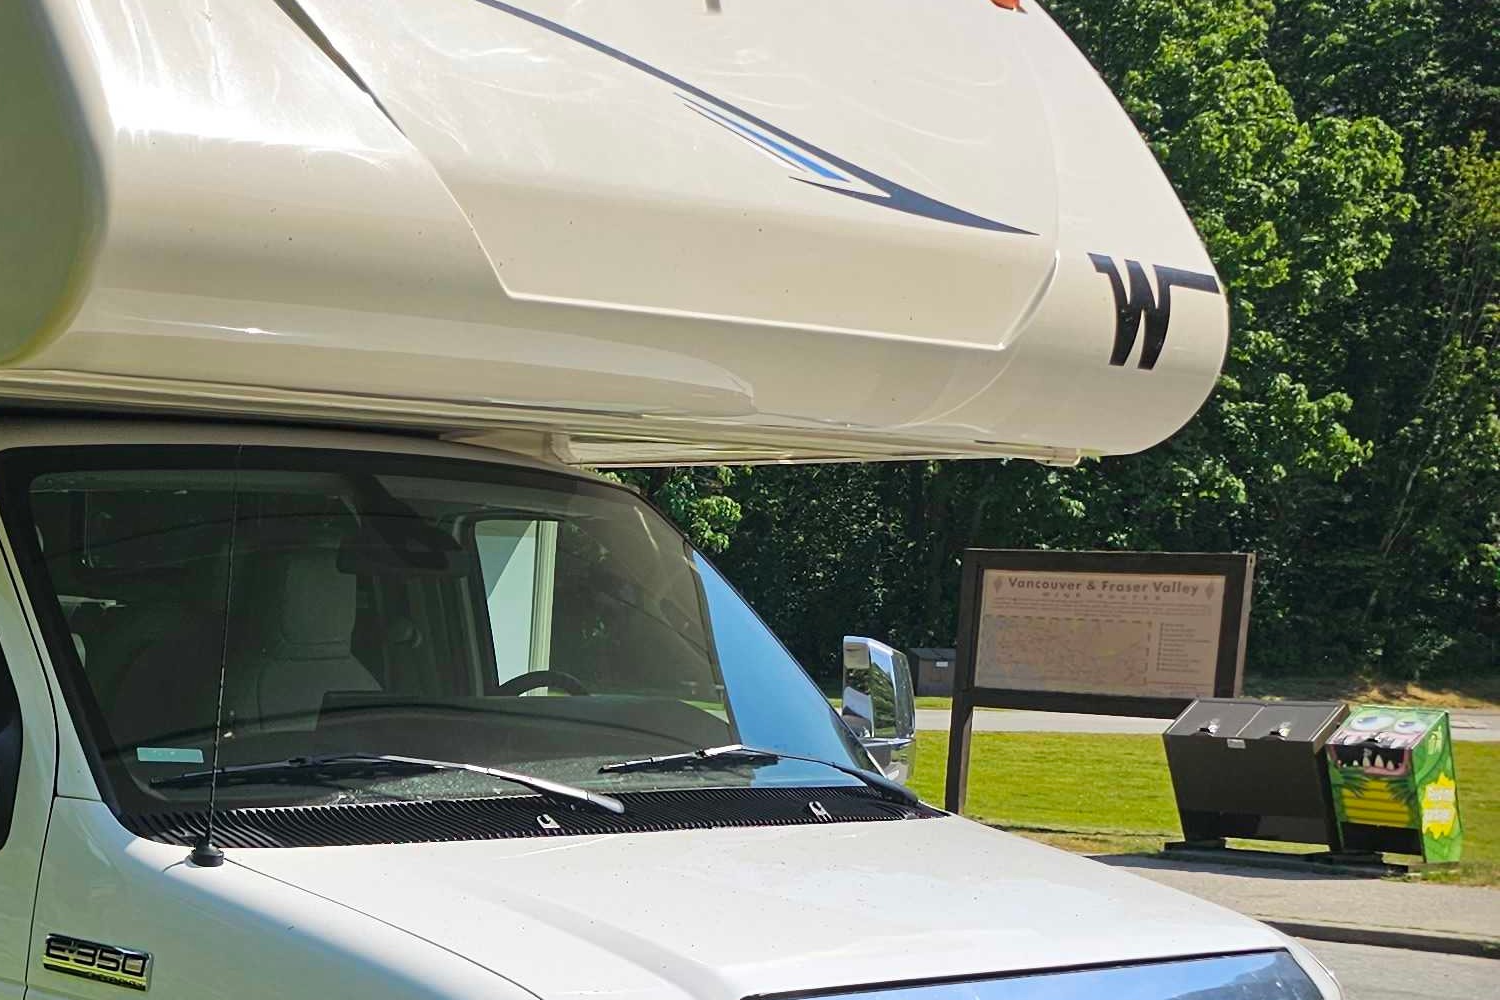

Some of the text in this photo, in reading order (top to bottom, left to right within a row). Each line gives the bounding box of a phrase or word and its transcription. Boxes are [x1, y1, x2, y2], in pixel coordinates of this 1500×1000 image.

[1008, 577, 1082, 591] Vancouver
[1086, 580, 1096, 591] &
[1101, 580, 1148, 593] Fraser
[1153, 581, 1199, 597] Valley
